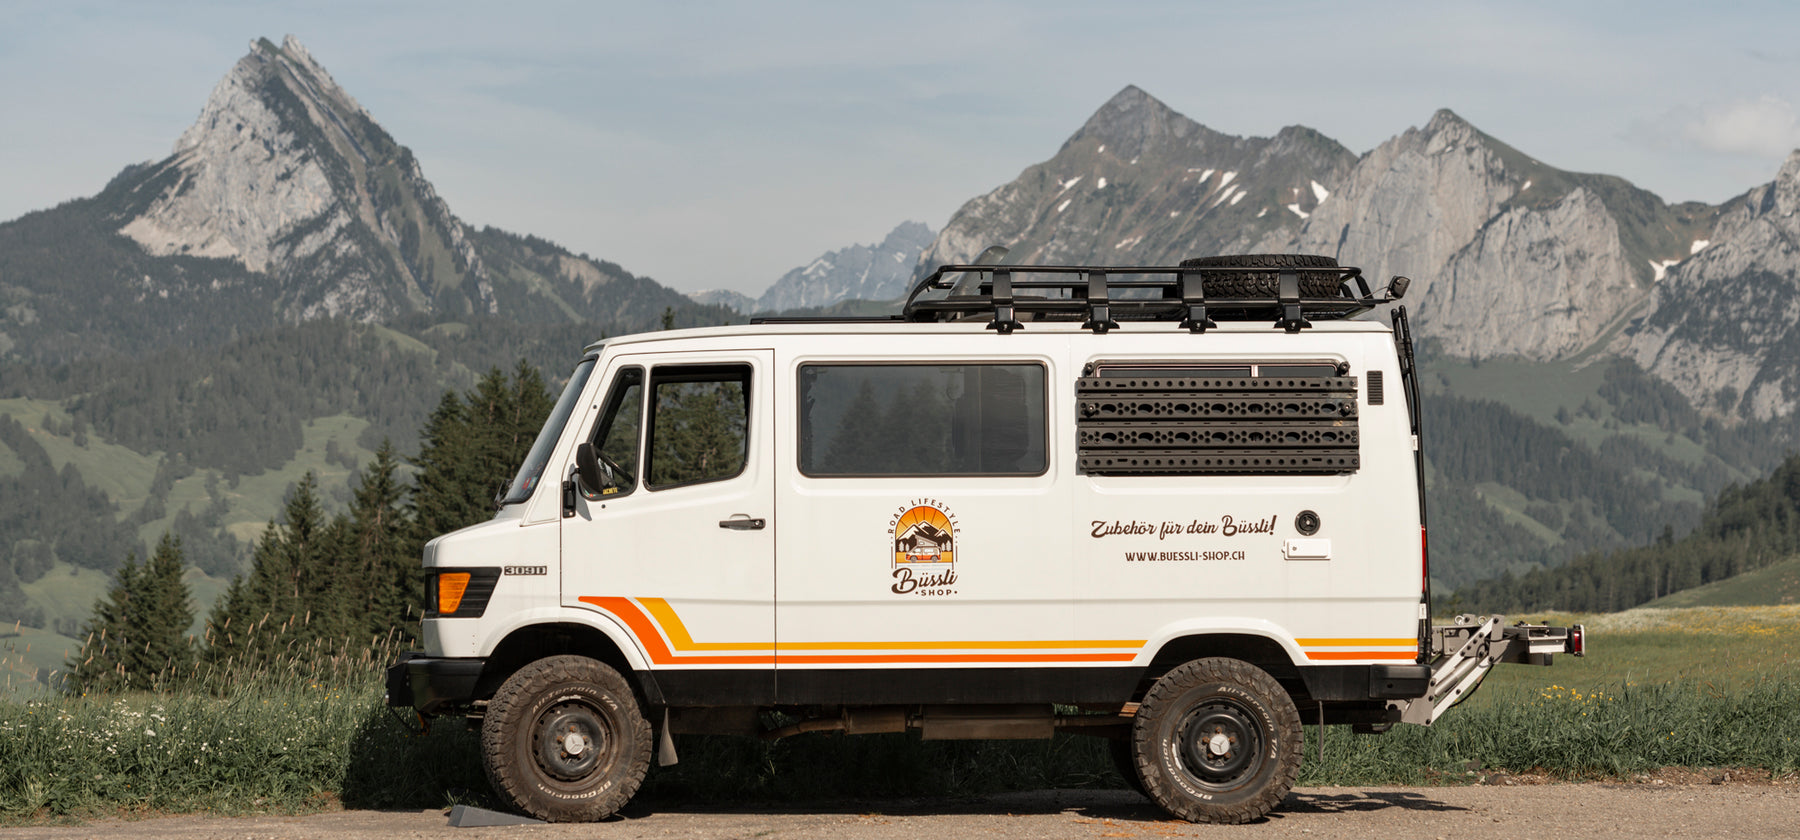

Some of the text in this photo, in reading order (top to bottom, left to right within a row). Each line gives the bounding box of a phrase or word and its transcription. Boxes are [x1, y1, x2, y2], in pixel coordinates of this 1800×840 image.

[888, 498, 960, 534] ROAD LIFESTYLE
[1091, 514, 1278, 540] Zubehör für dein Büssli!
[1125, 551, 1245, 562] WWW.BUESSLI-SHOP.CH
[504, 566, 547, 575] 309D
[891, 567, 958, 594] Büssli
[920, 589, 952, 597] SHOP
[532, 686, 619, 714] All-Terrain T/A
[1217, 686, 1278, 759] All-Terrain T/A
